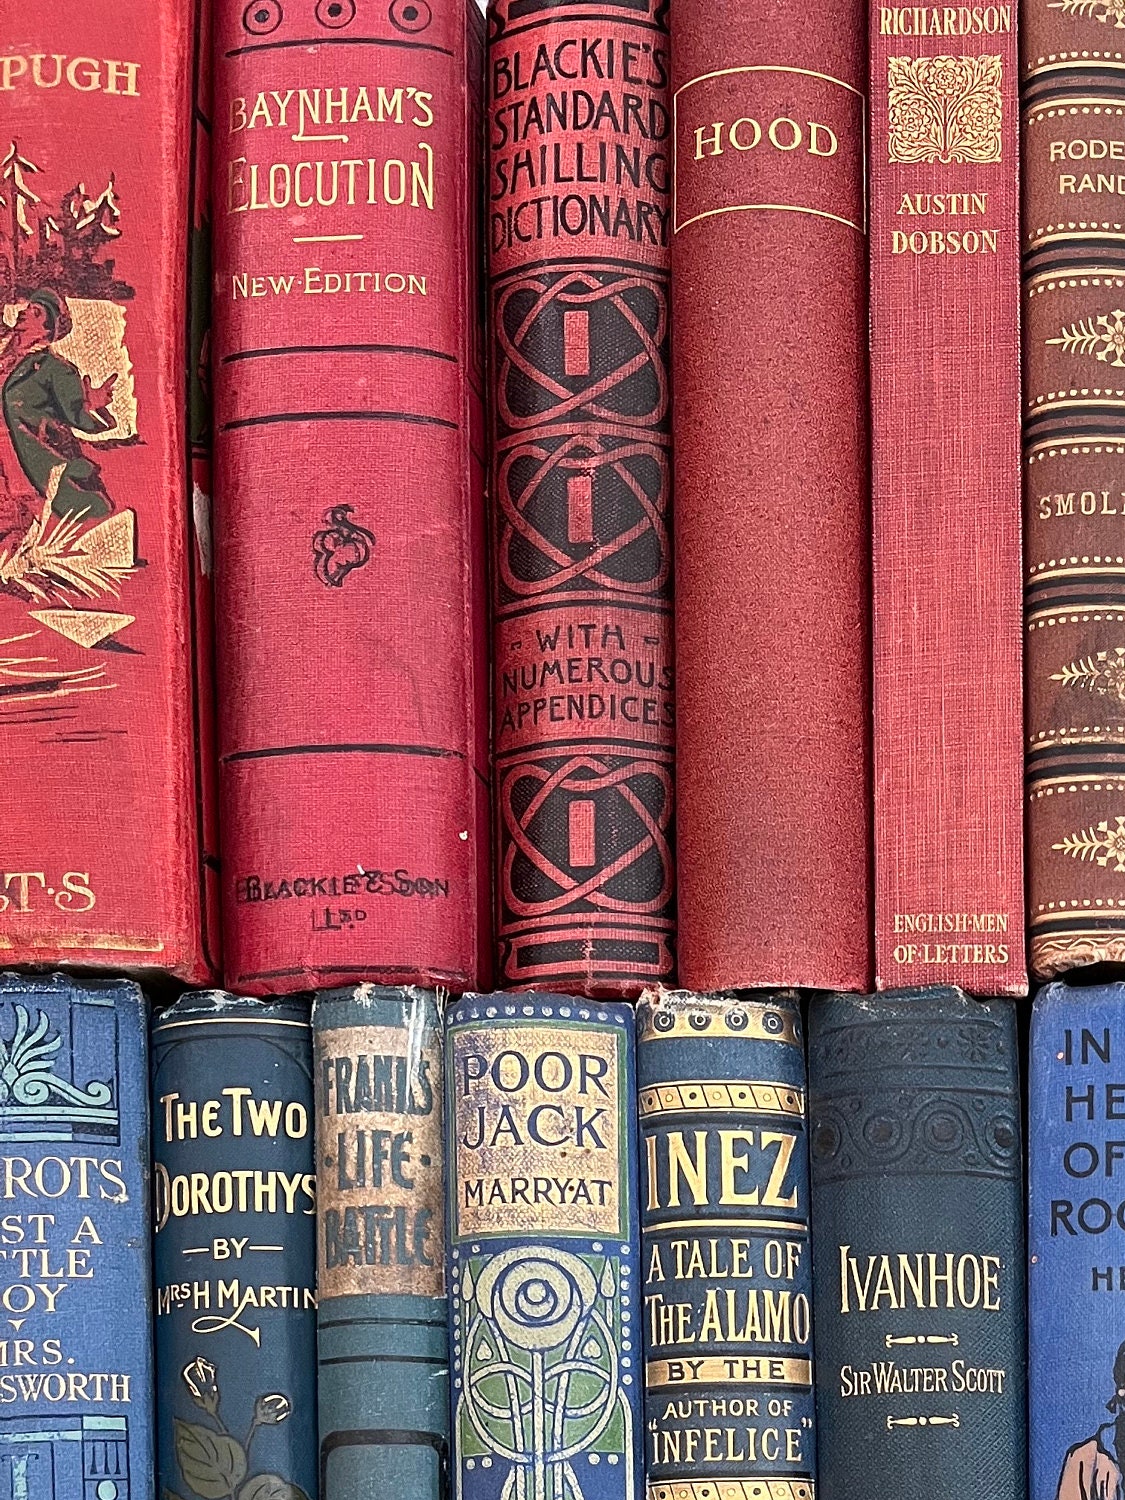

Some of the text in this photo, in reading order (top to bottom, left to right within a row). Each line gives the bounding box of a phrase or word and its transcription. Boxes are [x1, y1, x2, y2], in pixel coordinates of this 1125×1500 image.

[879, 7, 1011, 36] RICHARDSON
[0, 54, 140, 96] PUGH
[493, 38, 669, 99] BLACKIE'S
[227, 86, 434, 137] BAYNHAM'S
[492, 89, 669, 150] STANDARD
[693, 117, 838, 160] HOOD
[227, 142, 434, 214] ELOCUTION
[491, 194, 670, 250] DICTIONARY
[897, 192, 988, 215] AUSTIN
[892, 230, 998, 254] DOBSON
[536, 624, 626, 652] WITH
[502, 657, 674, 696] NUMEROUS
[500, 694, 676, 735] APPENDICES
[1064, 1028, 1110, 1067] IN
[462, 1050, 610, 1099] POOR
[160, 1087, 307, 1141] THE TWO
[463, 1104, 607, 1149] JACK
[465, 1177, 612, 1208] MARRYAT
[645, 1131, 799, 1213] INEZ
[154, 1161, 318, 1235] DOROTHYS
[71, 1216, 103, 1245] A
[213, 1238, 249, 1260] BY
[645, 1240, 802, 1284] A TALE OF
[839, 1246, 1001, 1314] IVANHOE
[194, 1280, 210, 1310] H
[645, 1289, 810, 1346] THE ALAMO
[668, 1361, 785, 1381] BY THE
[840, 1361, 1006, 1398] SIR WALTER SCOTT
[662, 1400, 793, 1420] AUTHOR OF
